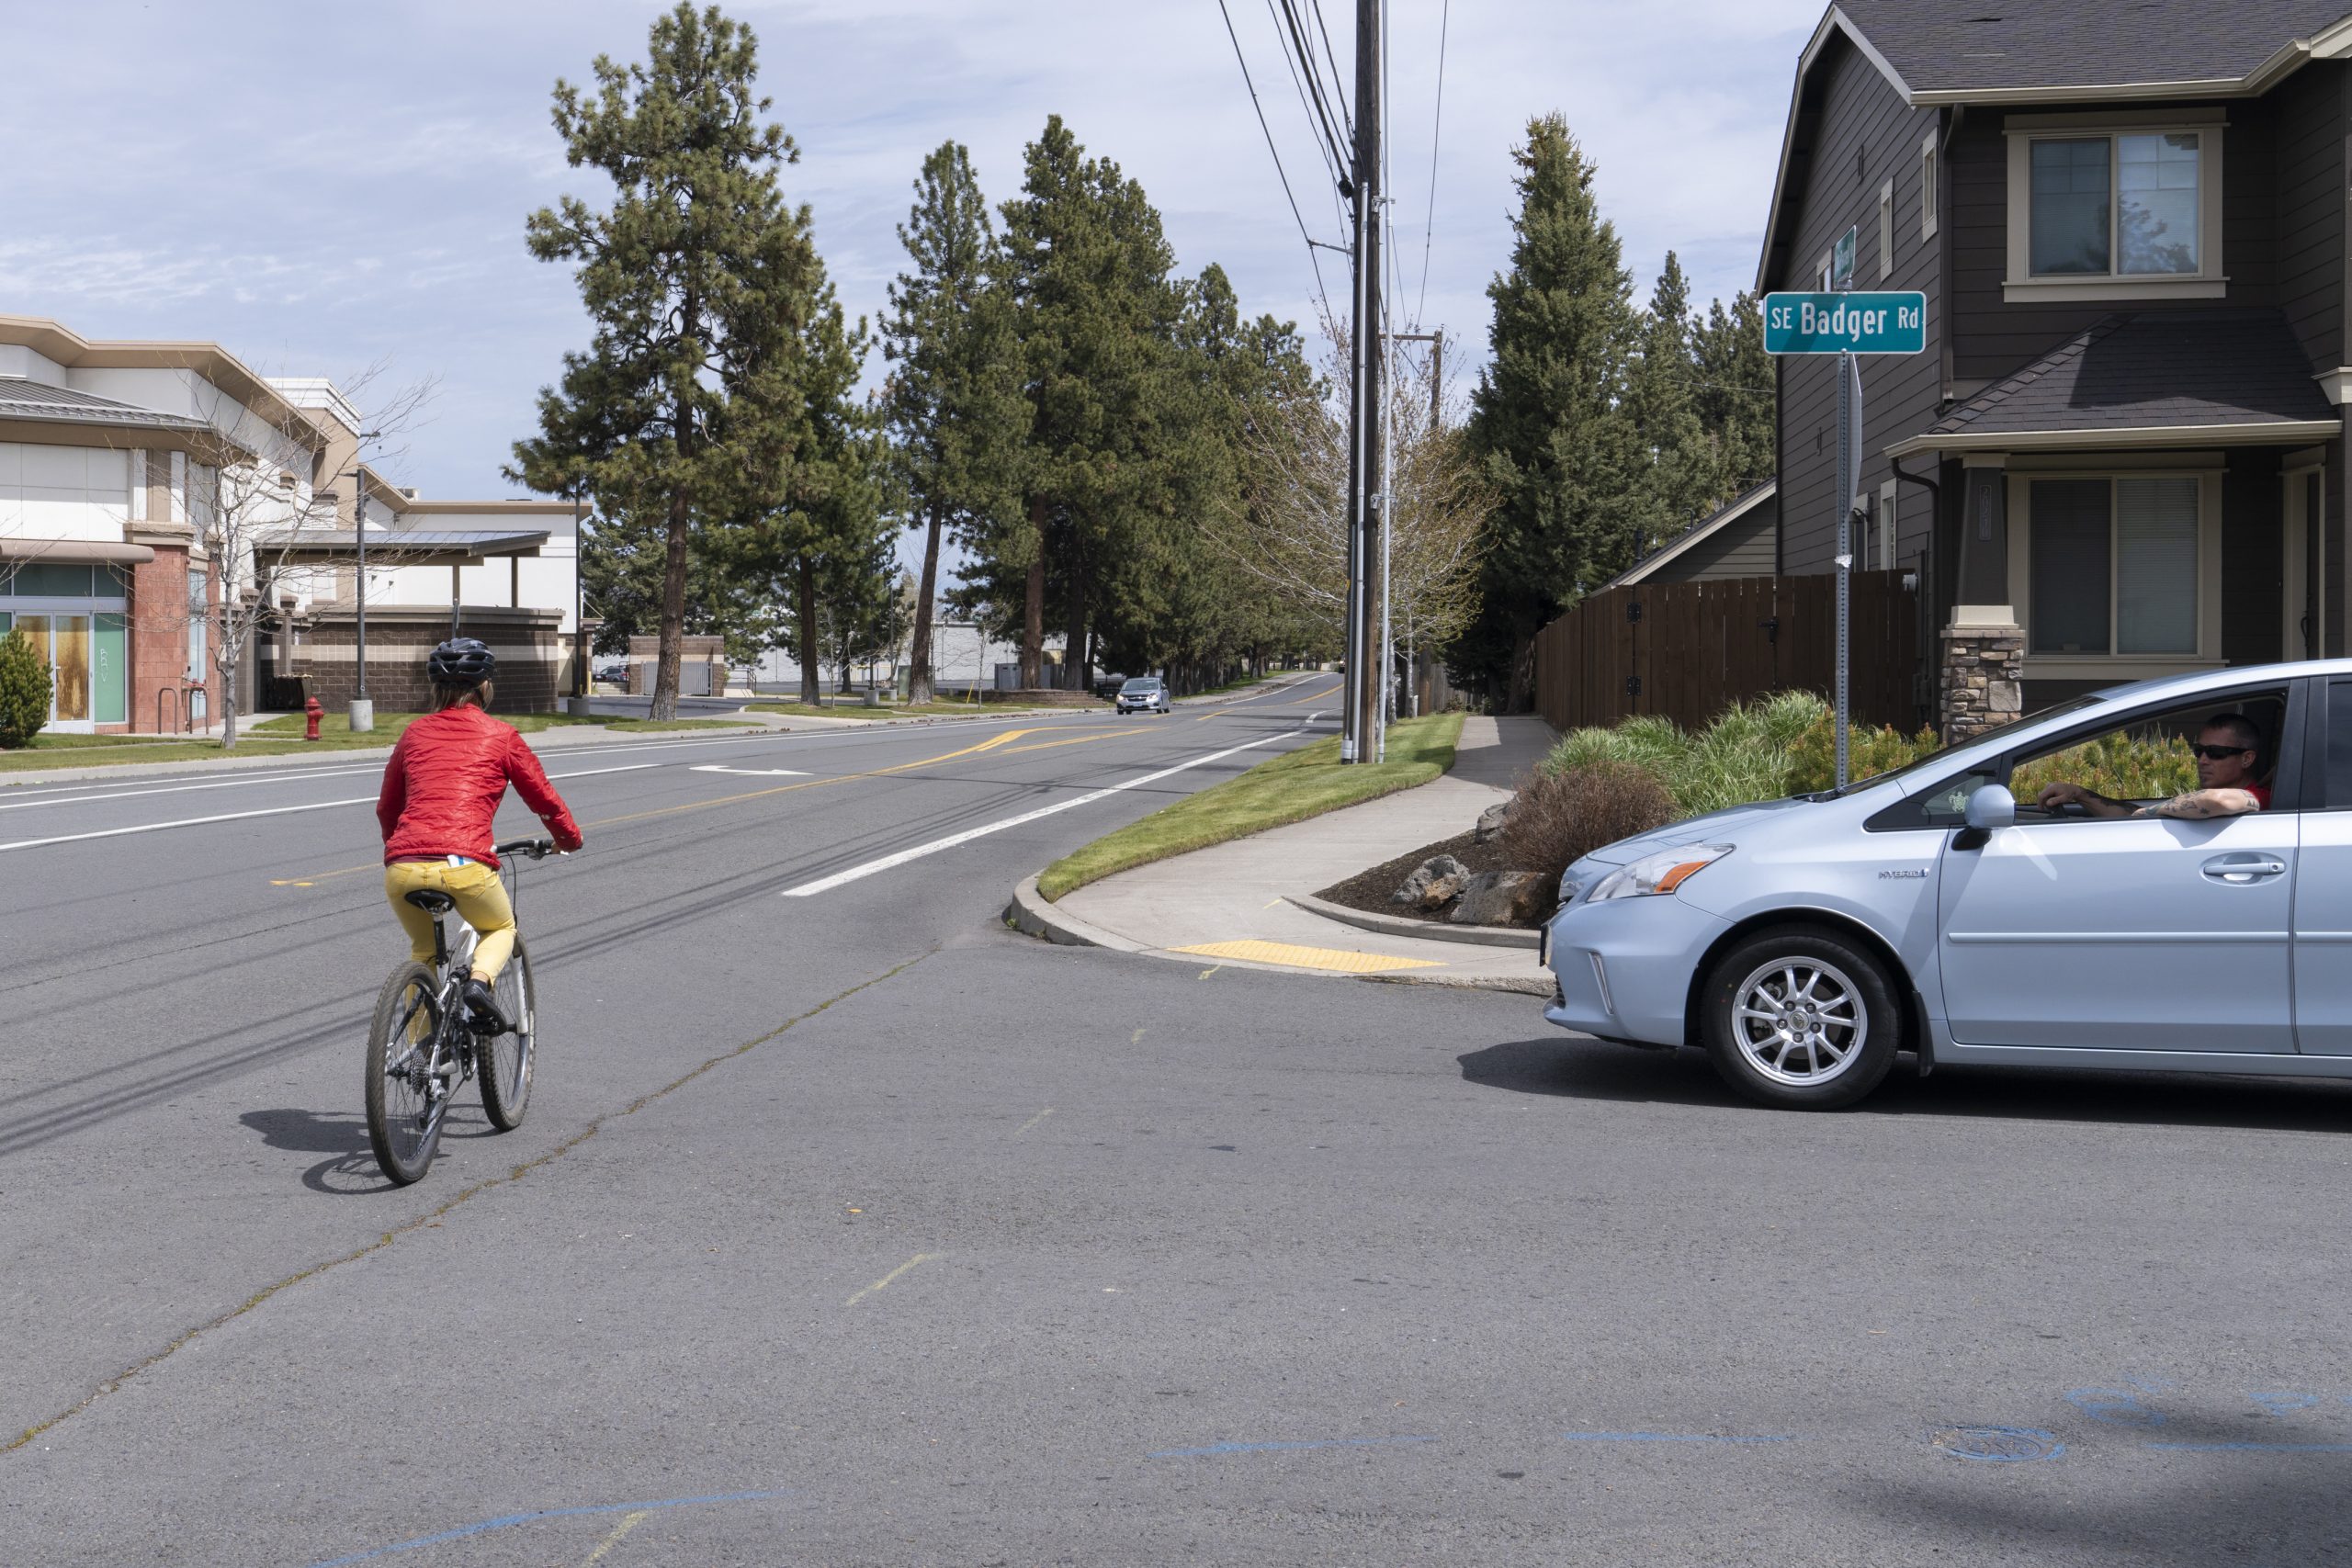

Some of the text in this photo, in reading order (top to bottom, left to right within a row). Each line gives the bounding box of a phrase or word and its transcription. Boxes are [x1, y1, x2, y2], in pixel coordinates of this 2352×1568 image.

[1771, 302, 1918, 343] SE Badger Rd
[1879, 871, 1920, 880] HYBRID
